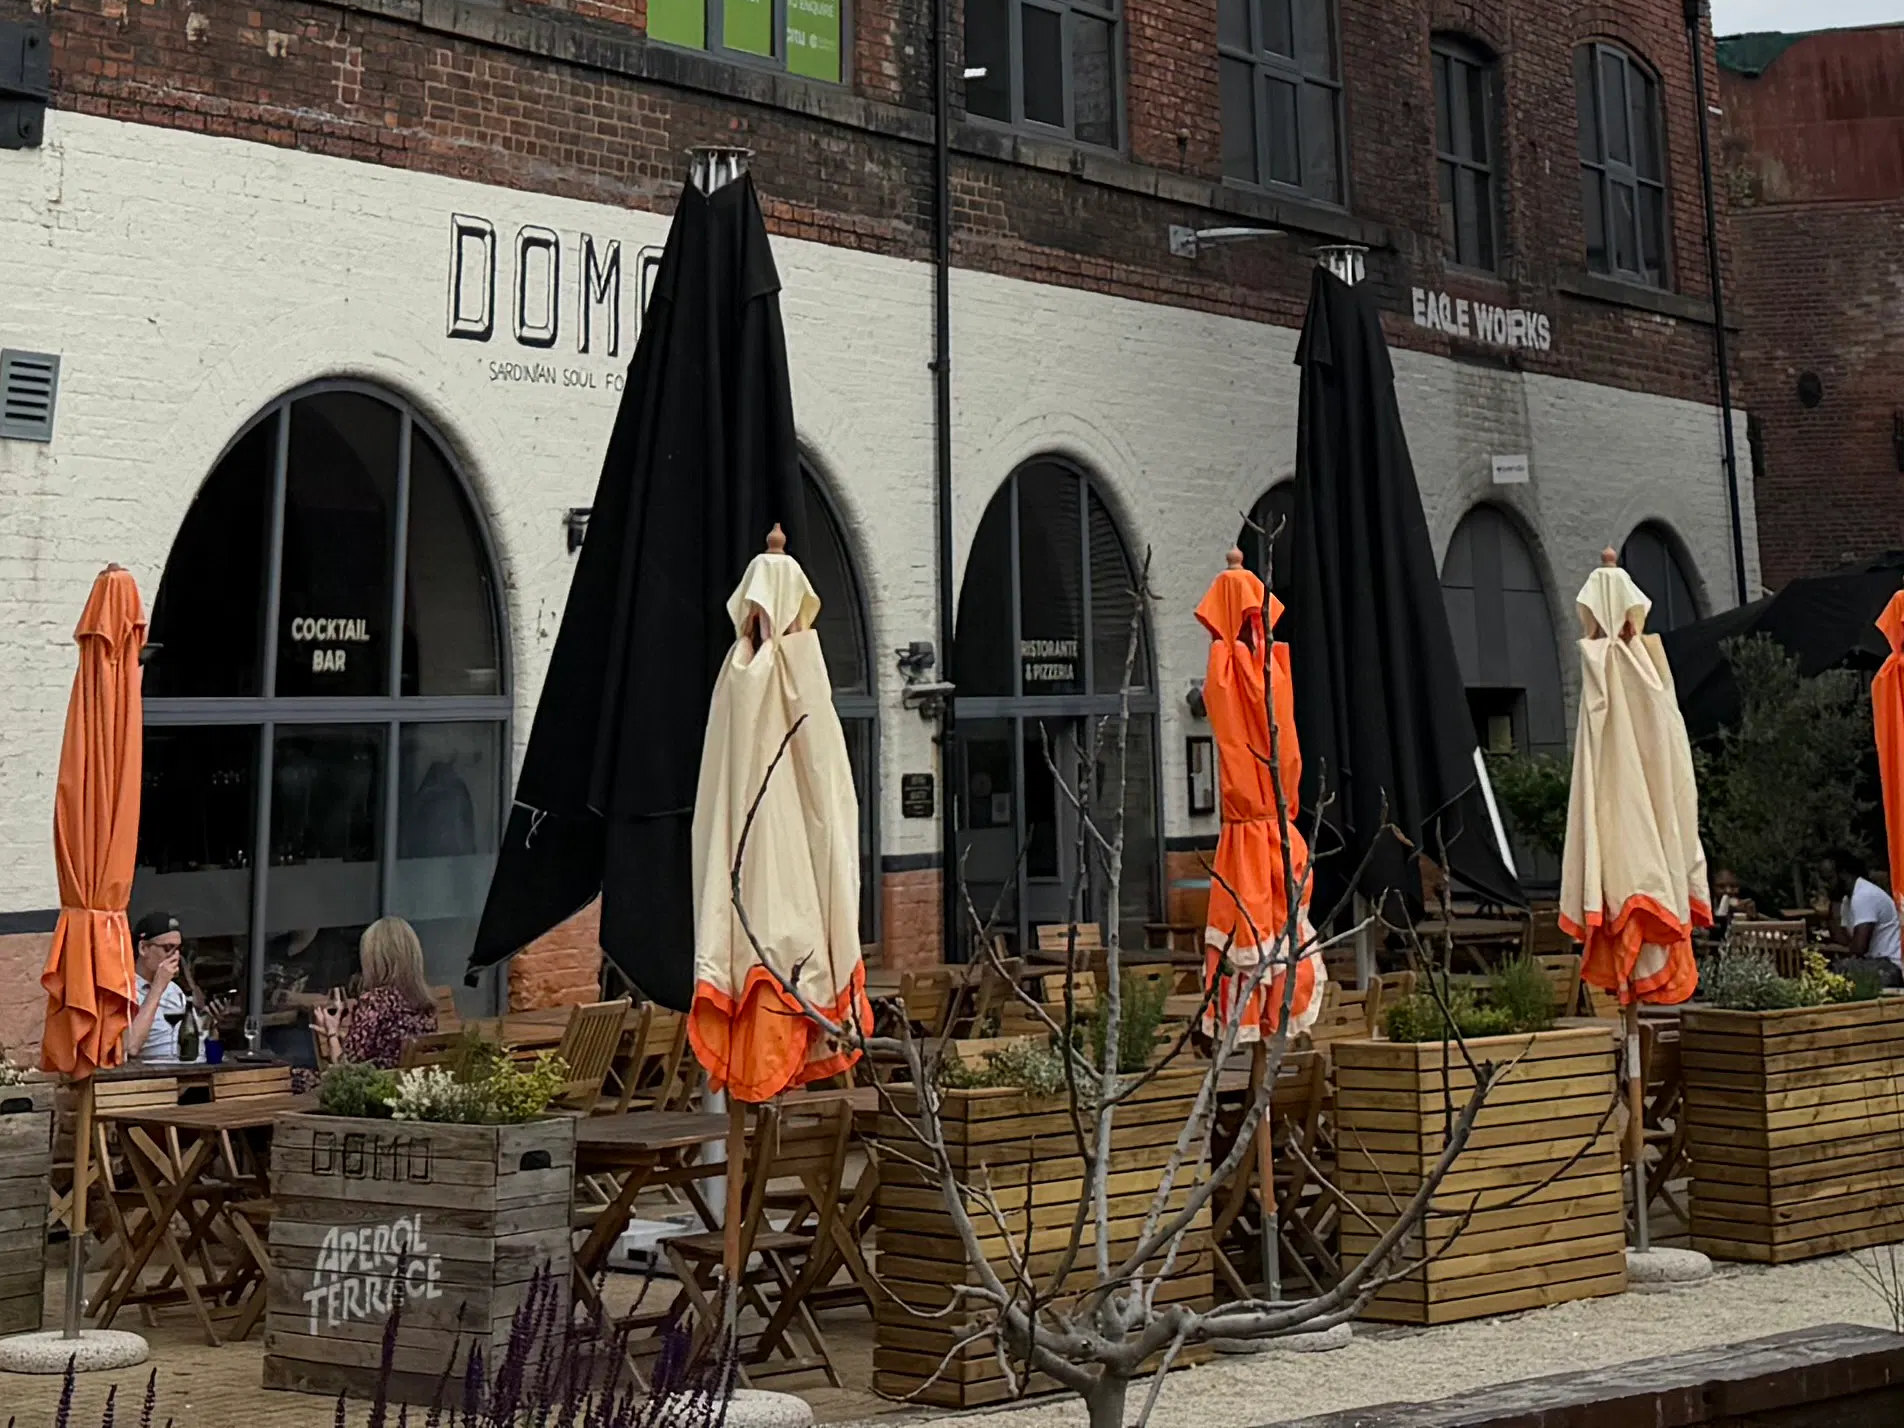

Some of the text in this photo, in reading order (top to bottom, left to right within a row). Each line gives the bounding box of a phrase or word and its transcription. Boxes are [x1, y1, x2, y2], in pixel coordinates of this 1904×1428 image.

[1411, 286, 1552, 352] EAGLE WORKS
[489, 361, 625, 392] SARDINIAN SOUL FO
[291, 616, 371, 641] COCKTAIL
[312, 649, 346, 673] BAR
[1020, 639, 1078, 658] RISTORANTE
[1032, 663, 1075, 681] PIZZERIA
[311, 1130, 433, 1185] DOMO
[313, 1212, 428, 1288] APEROL
[302, 1253, 444, 1336] TERRACE
